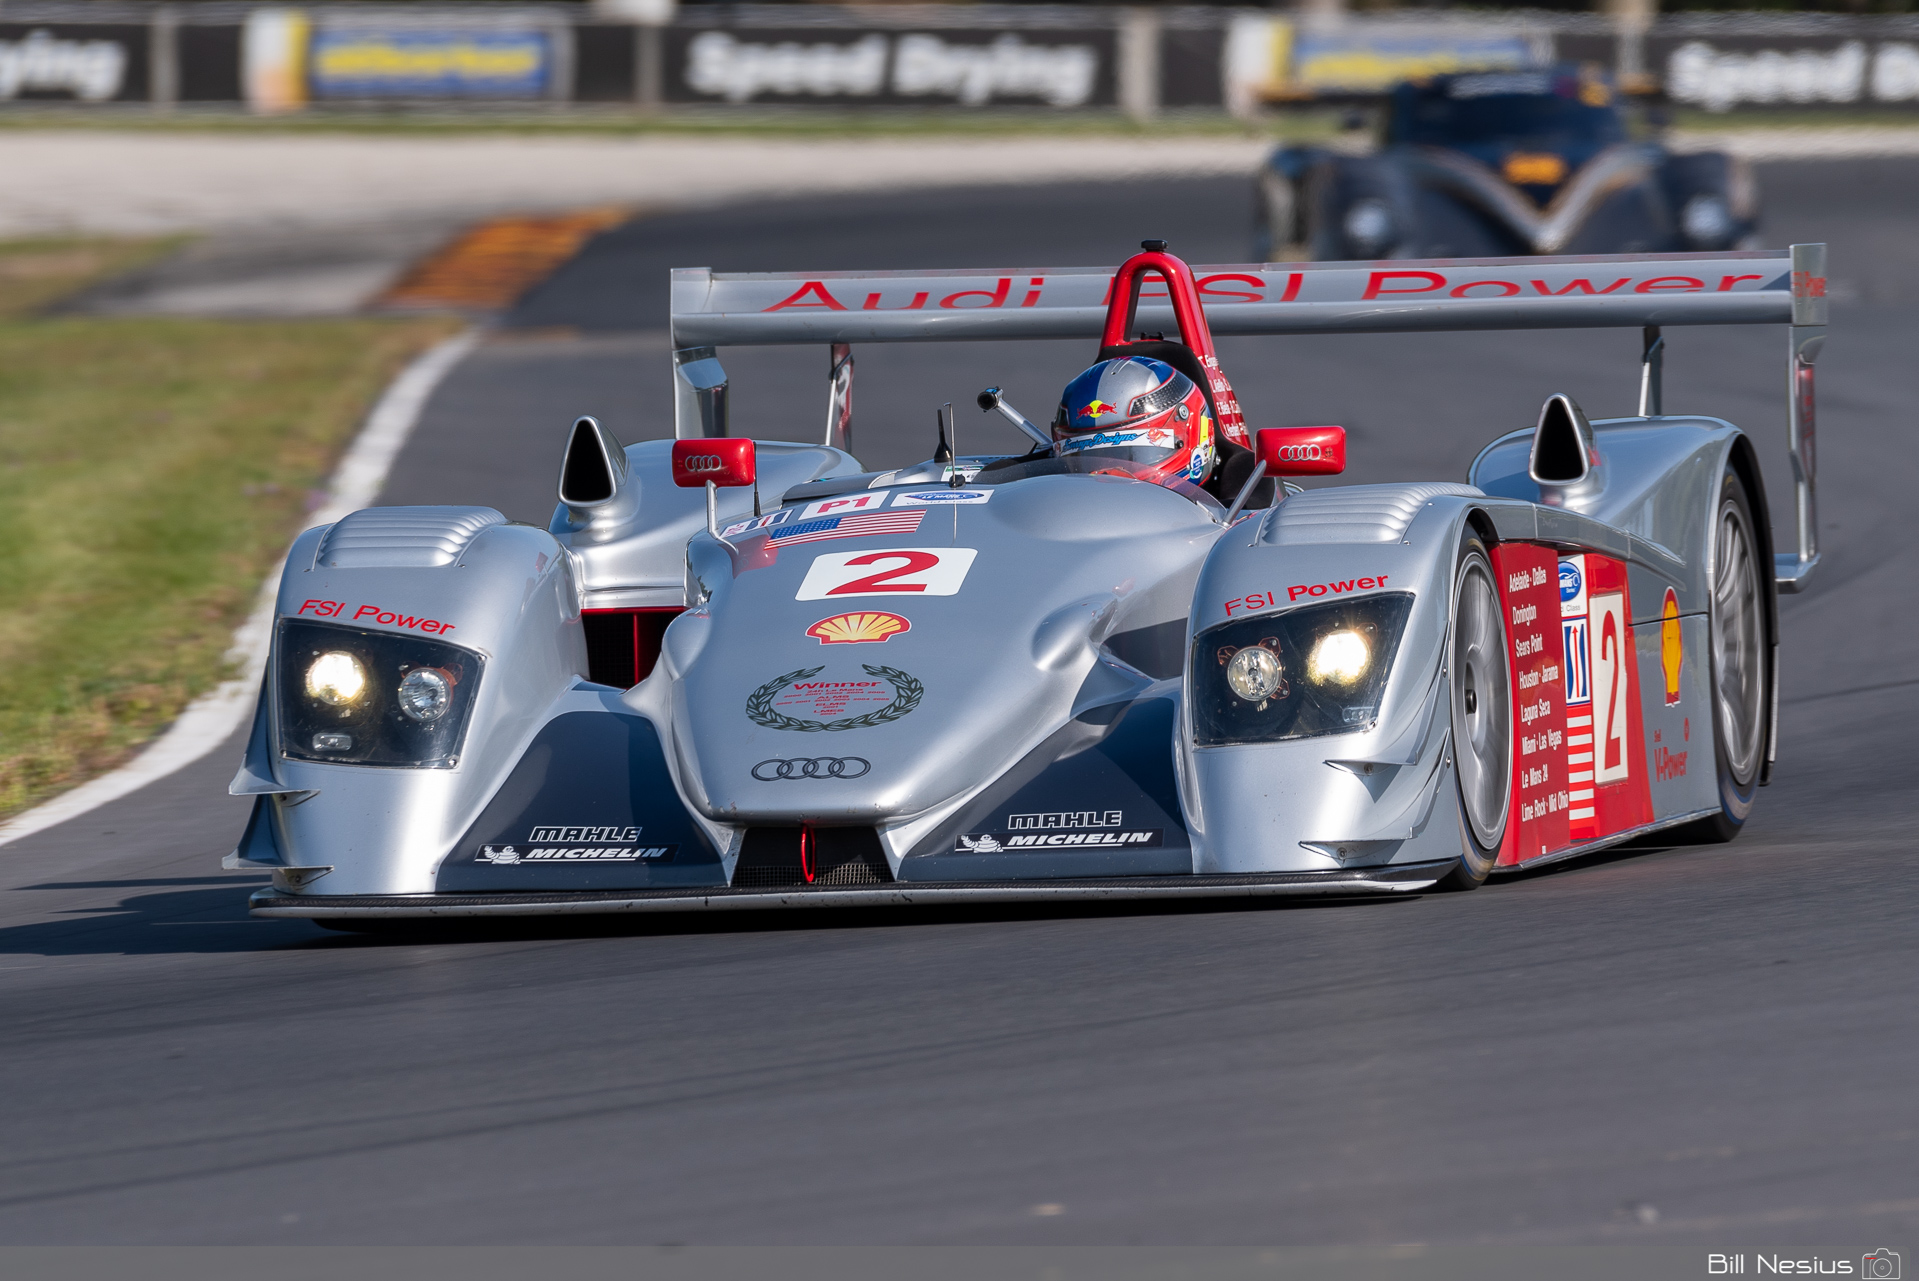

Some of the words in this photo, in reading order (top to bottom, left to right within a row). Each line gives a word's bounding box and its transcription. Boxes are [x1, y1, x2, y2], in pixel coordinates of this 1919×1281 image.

[760, 277, 1045, 313] Audi
[1361, 271, 1764, 300] Power
[817, 496, 871, 514] P1
[825, 551, 939, 595] 2
[1509, 570, 1529, 593] Adelaide
[1532, 566, 1547, 586] Dallas
[1224, 591, 1275, 617] FSI
[1287, 575, 1389, 601] Power
[297, 599, 346, 618] FSI
[353, 605, 456, 635] Power
[1512, 603, 1537, 626] Donington
[1515, 639, 1530, 658] Sears
[1530, 633, 1543, 653] Point
[794, 682, 882, 690] Winner
[1519, 669, 1539, 690] Houston
[1542, 664, 1559, 683] Jarama
[1602, 610, 1621, 770] 2
[1521, 704, 1538, 726] Laguna
[1538, 698, 1551, 717] Seca
[1522, 733, 1536, 756] Miami
[1538, 732, 1547, 750] Las
[1547, 728, 1562, 751] Vegas
[1653, 746, 1688, 783] V-Power
[1521, 770, 1529, 789] Le
[1529, 767, 1542, 787] Mans
[1521, 803, 1534, 822] Lime
[1534, 797, 1546, 818] Rock
[1548, 793, 1557, 813] Mid
[1557, 789, 1569, 810] Ohio
[1007, 810, 1122, 830] MAHLE
[528, 826, 643, 843] MAHLE
[1007, 832, 1153, 846] MICHELIN
[525, 847, 668, 859] MICHELIN
